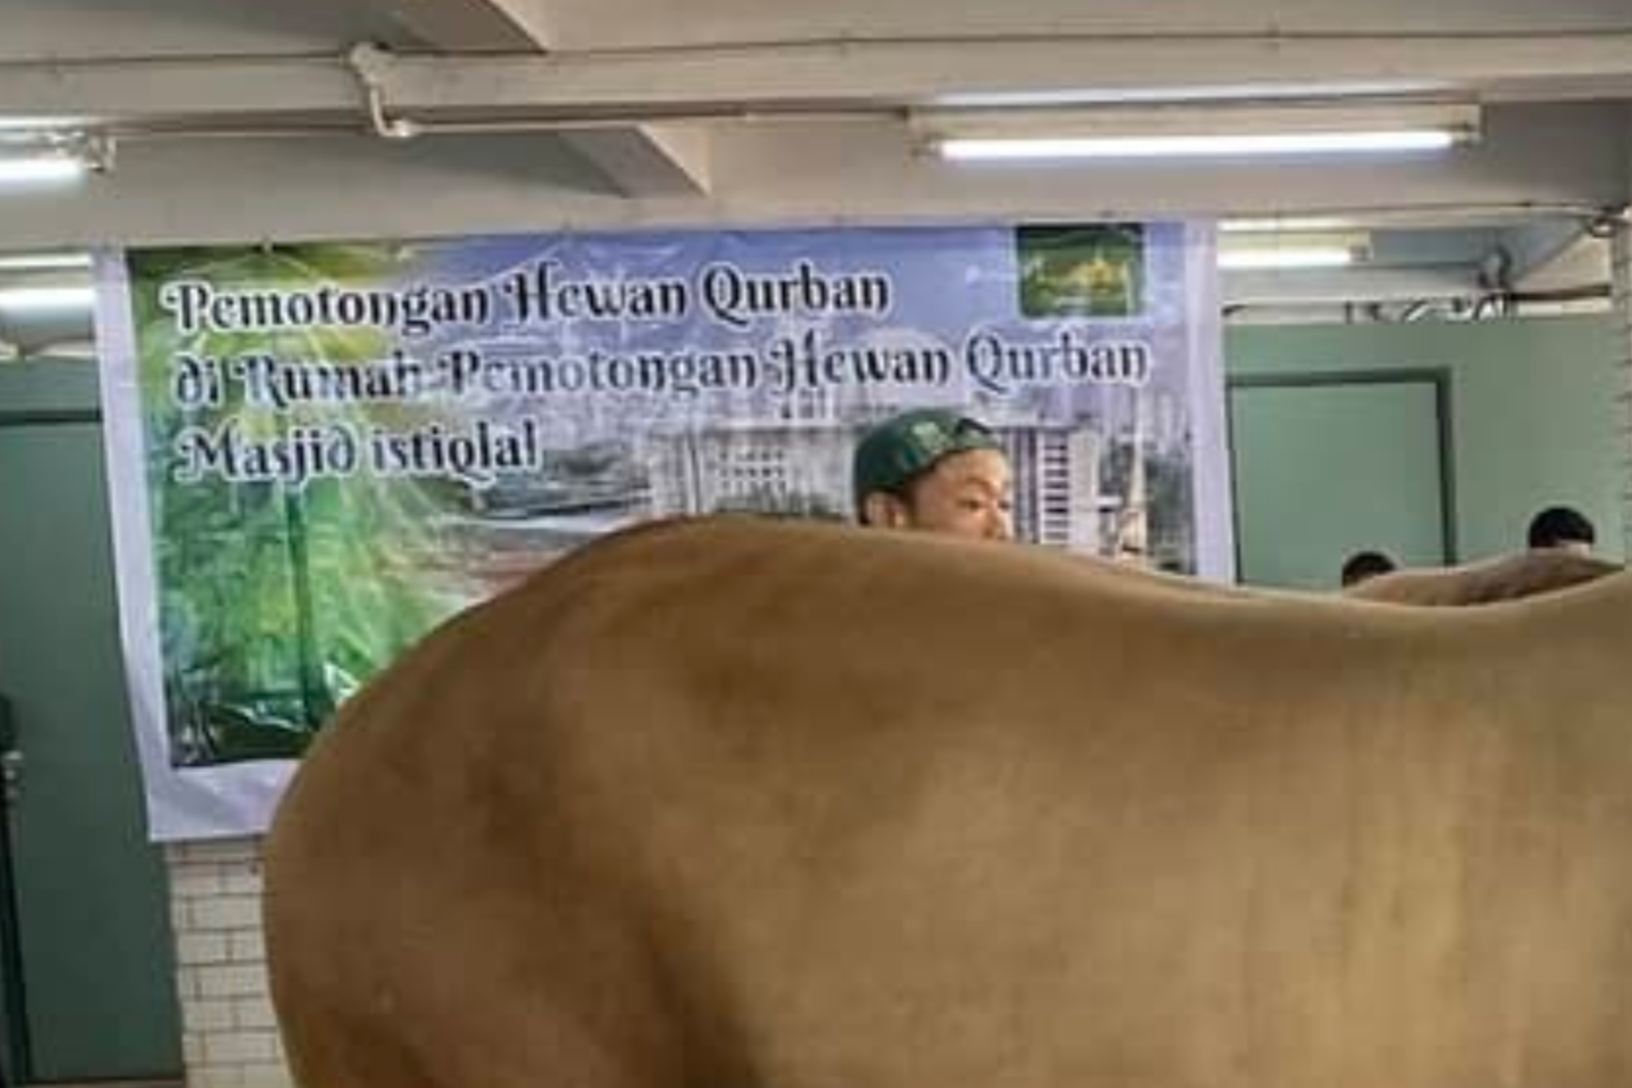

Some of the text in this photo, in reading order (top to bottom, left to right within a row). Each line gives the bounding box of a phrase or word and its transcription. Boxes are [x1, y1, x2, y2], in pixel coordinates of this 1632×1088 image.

[165, 260, 890, 338] Pemotongan Hewan Qurban
[176, 328, 1149, 407] di Rumah Pemotongan Hewan Qurban
[178, 422, 357, 482] Masjid
